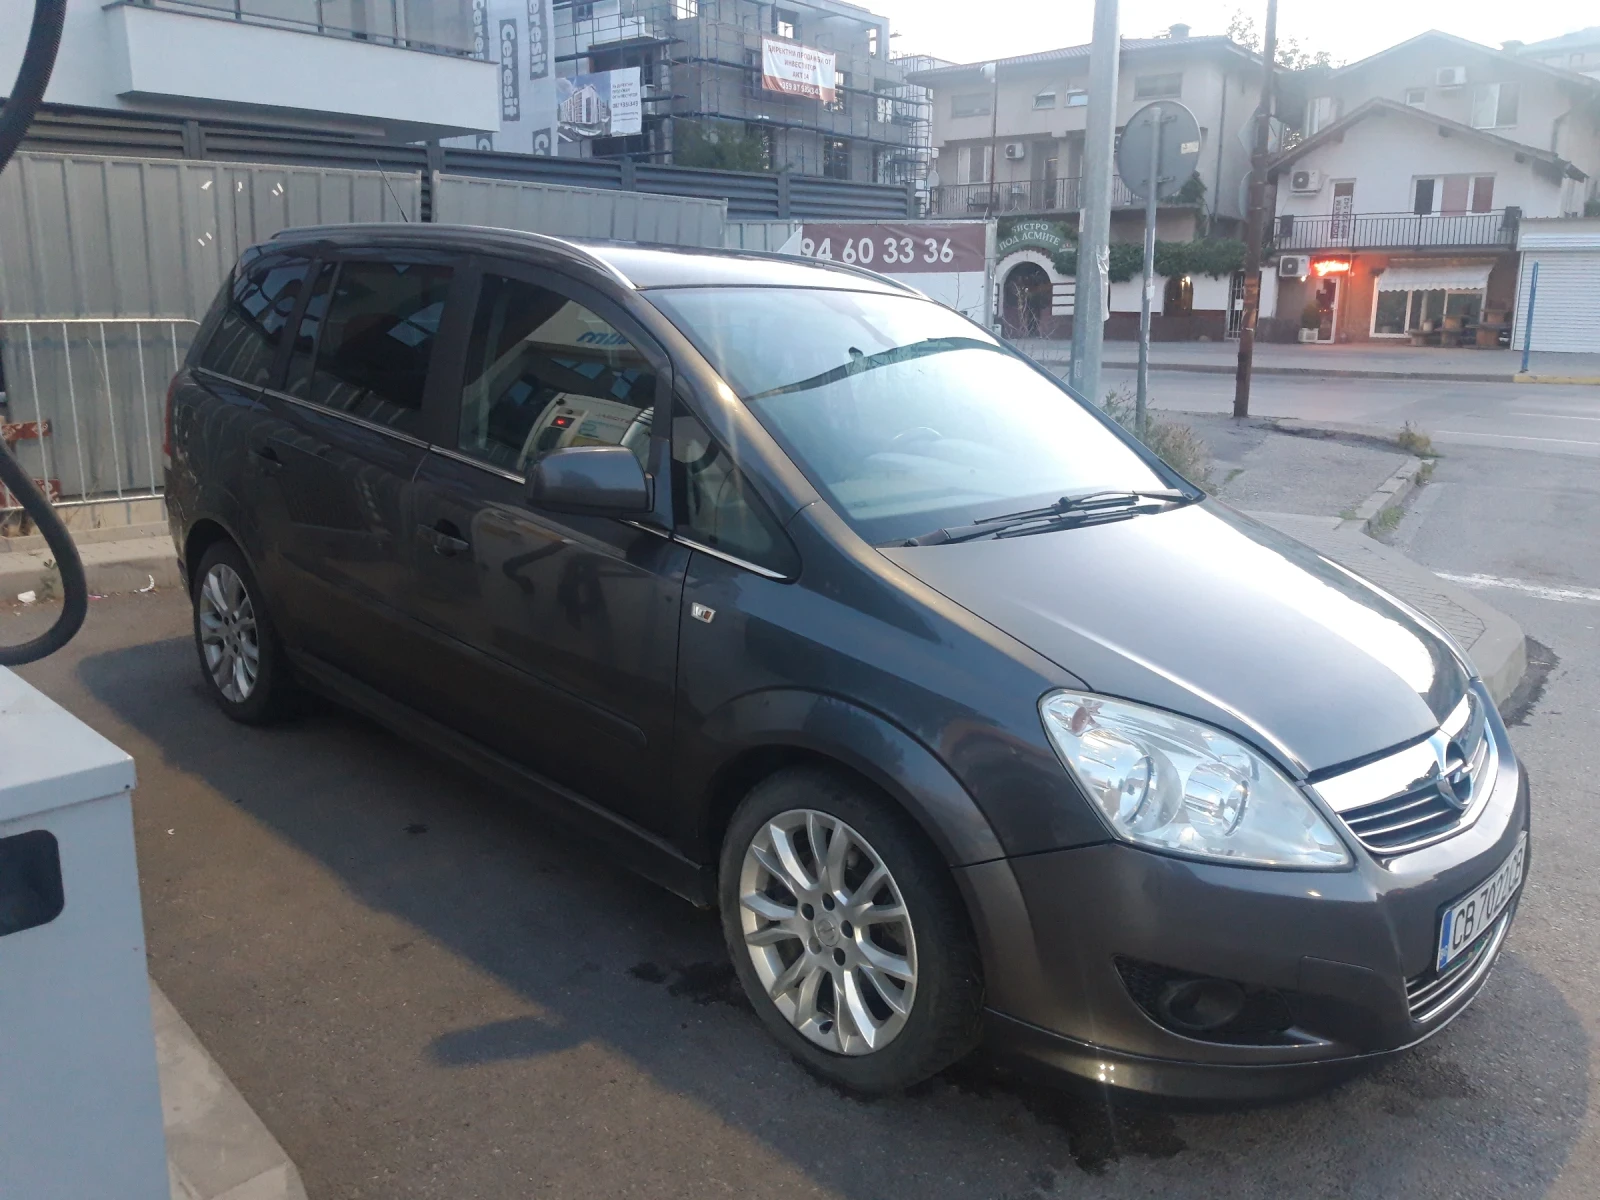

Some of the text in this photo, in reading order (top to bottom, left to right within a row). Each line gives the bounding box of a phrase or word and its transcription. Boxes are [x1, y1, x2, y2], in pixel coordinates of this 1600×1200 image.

[472, 0, 484, 60] Ceres
[529, 0, 547, 74] eresit
[501, 24, 518, 116] Ceresit
[801, 238, 954, 263] 94 60 33 36
[999, 235, 1019, 250] ПОД
[1011, 223, 1048, 232] БИСТРО
[1453, 901, 1475, 951] CB
